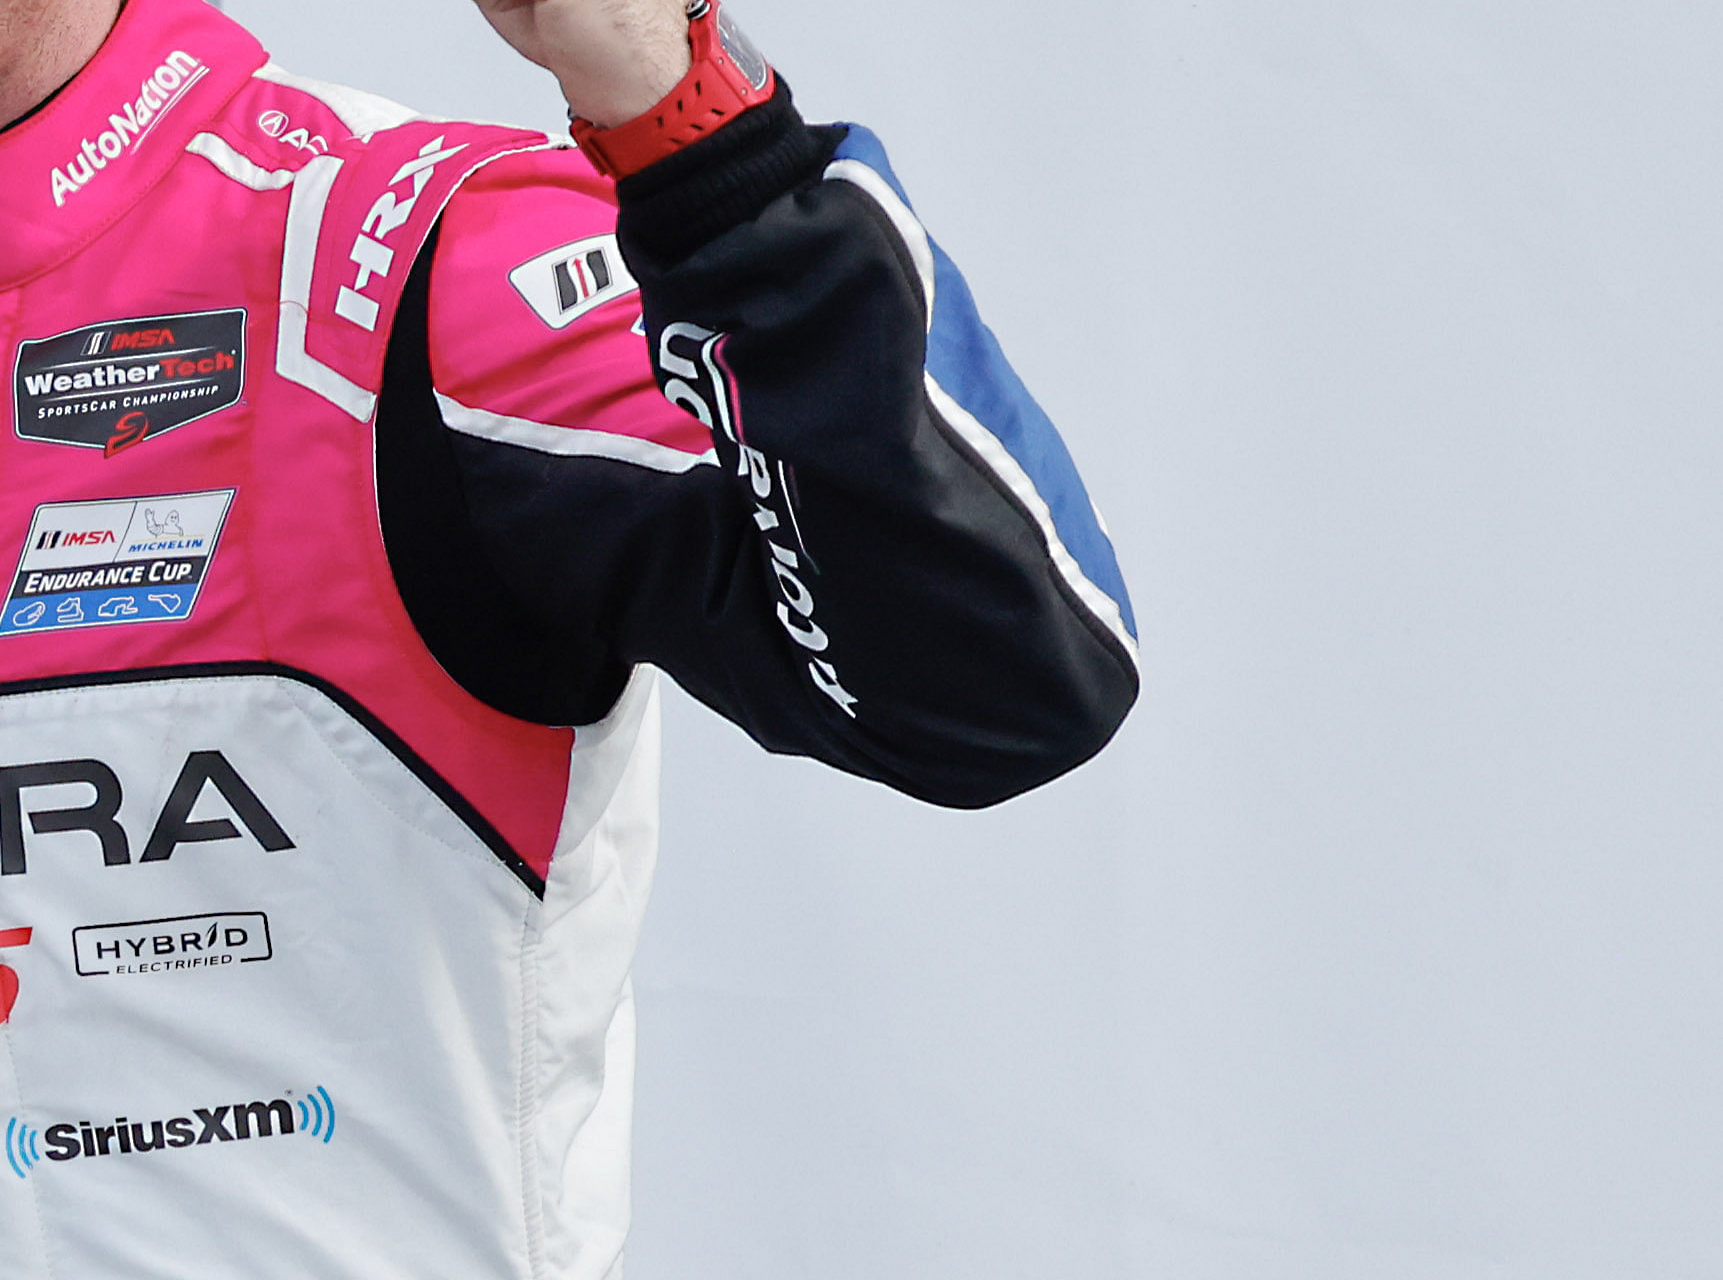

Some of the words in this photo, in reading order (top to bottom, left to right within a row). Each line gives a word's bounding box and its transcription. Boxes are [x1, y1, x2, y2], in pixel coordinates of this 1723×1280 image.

[49, 49, 200, 208] AutoNation
[334, 135, 470, 332] HRX
[111, 329, 175, 350] IMSA
[24, 352, 236, 396] WeatherTech
[123, 385, 220, 407] CHAMPIONSHIP
[62, 530, 116, 548] IMSA
[128, 538, 205, 553] MICHELIN
[24, 566, 146, 593] ENDURANCE
[148, 561, 193, 582] CUP
[95, 922, 250, 960] HYBRID
[116, 953, 234, 975] ELECTRIFIED
